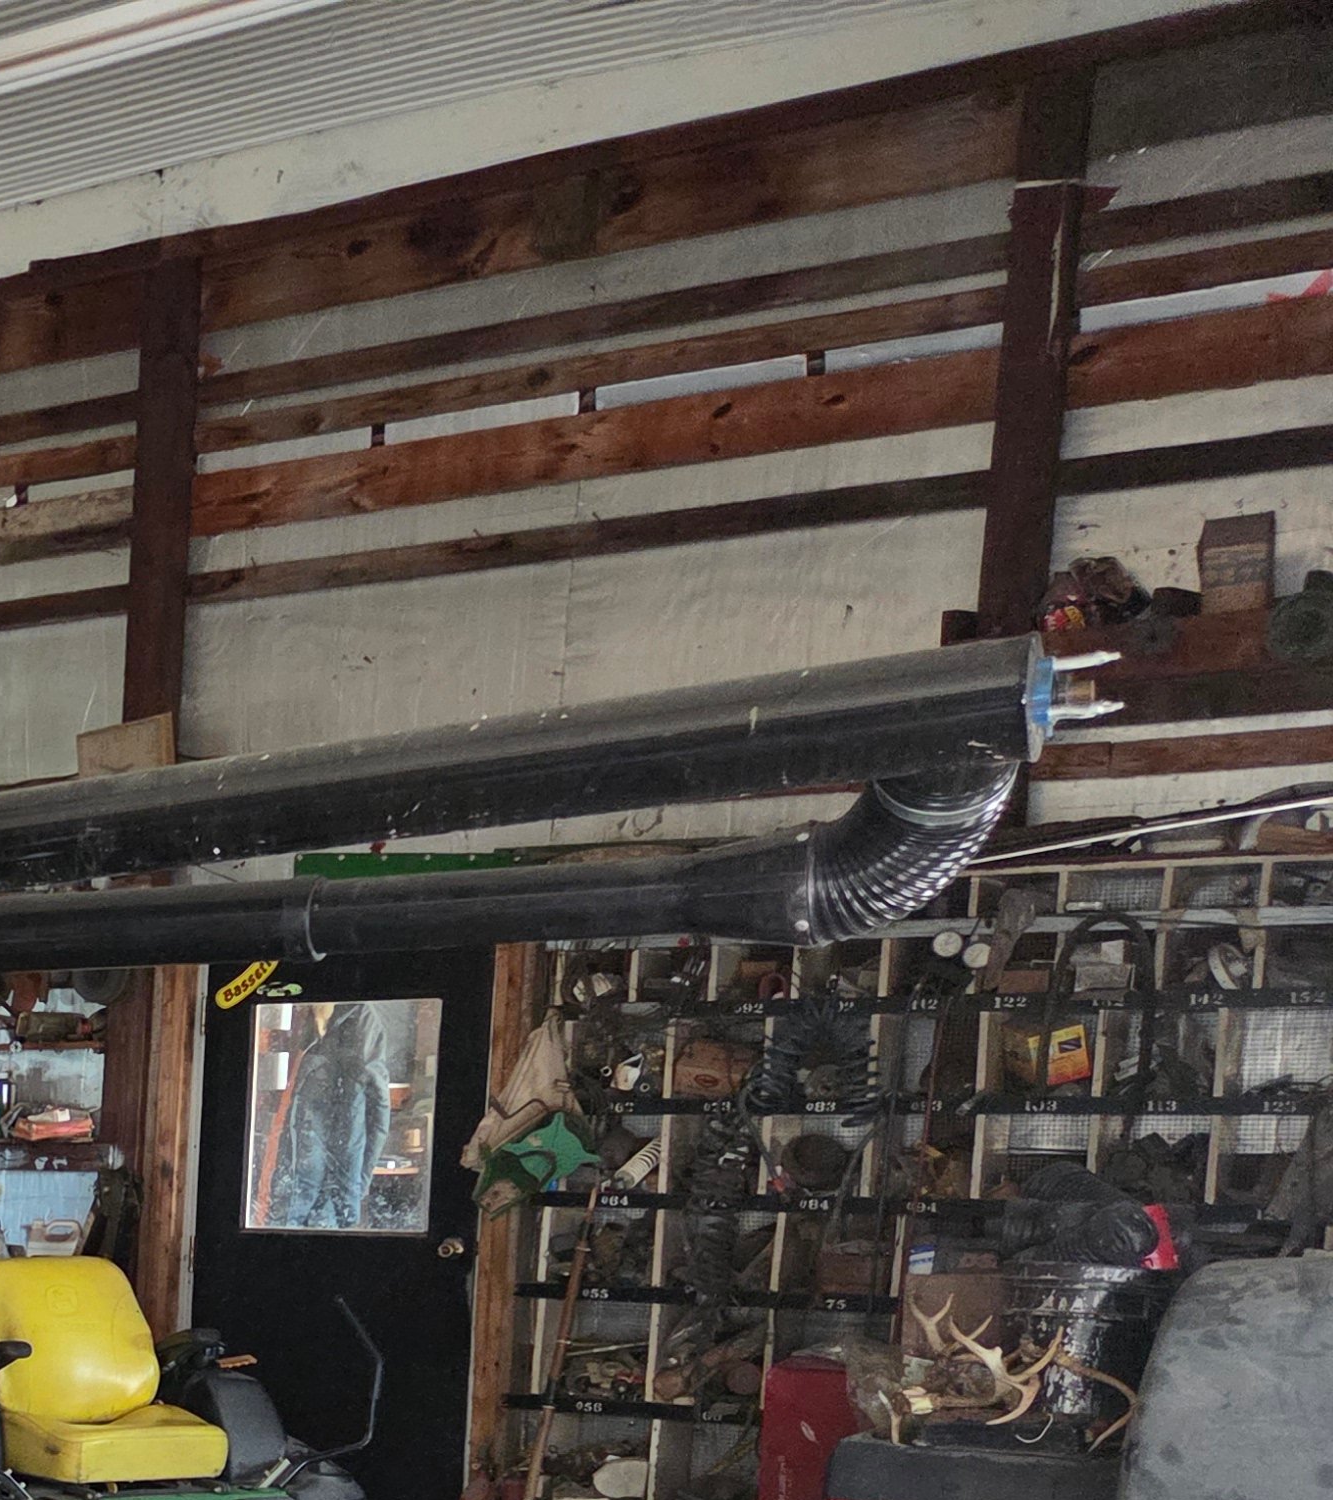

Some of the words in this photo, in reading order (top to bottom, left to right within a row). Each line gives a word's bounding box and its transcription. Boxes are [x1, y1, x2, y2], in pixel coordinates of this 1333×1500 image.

[993, 996, 1028, 1009] 122
[1189, 993, 1224, 1005] 142
[805, 1102, 836, 1112] 083
[1147, 1100, 1177, 1112] 113
[799, 1199, 829, 1211] 084
